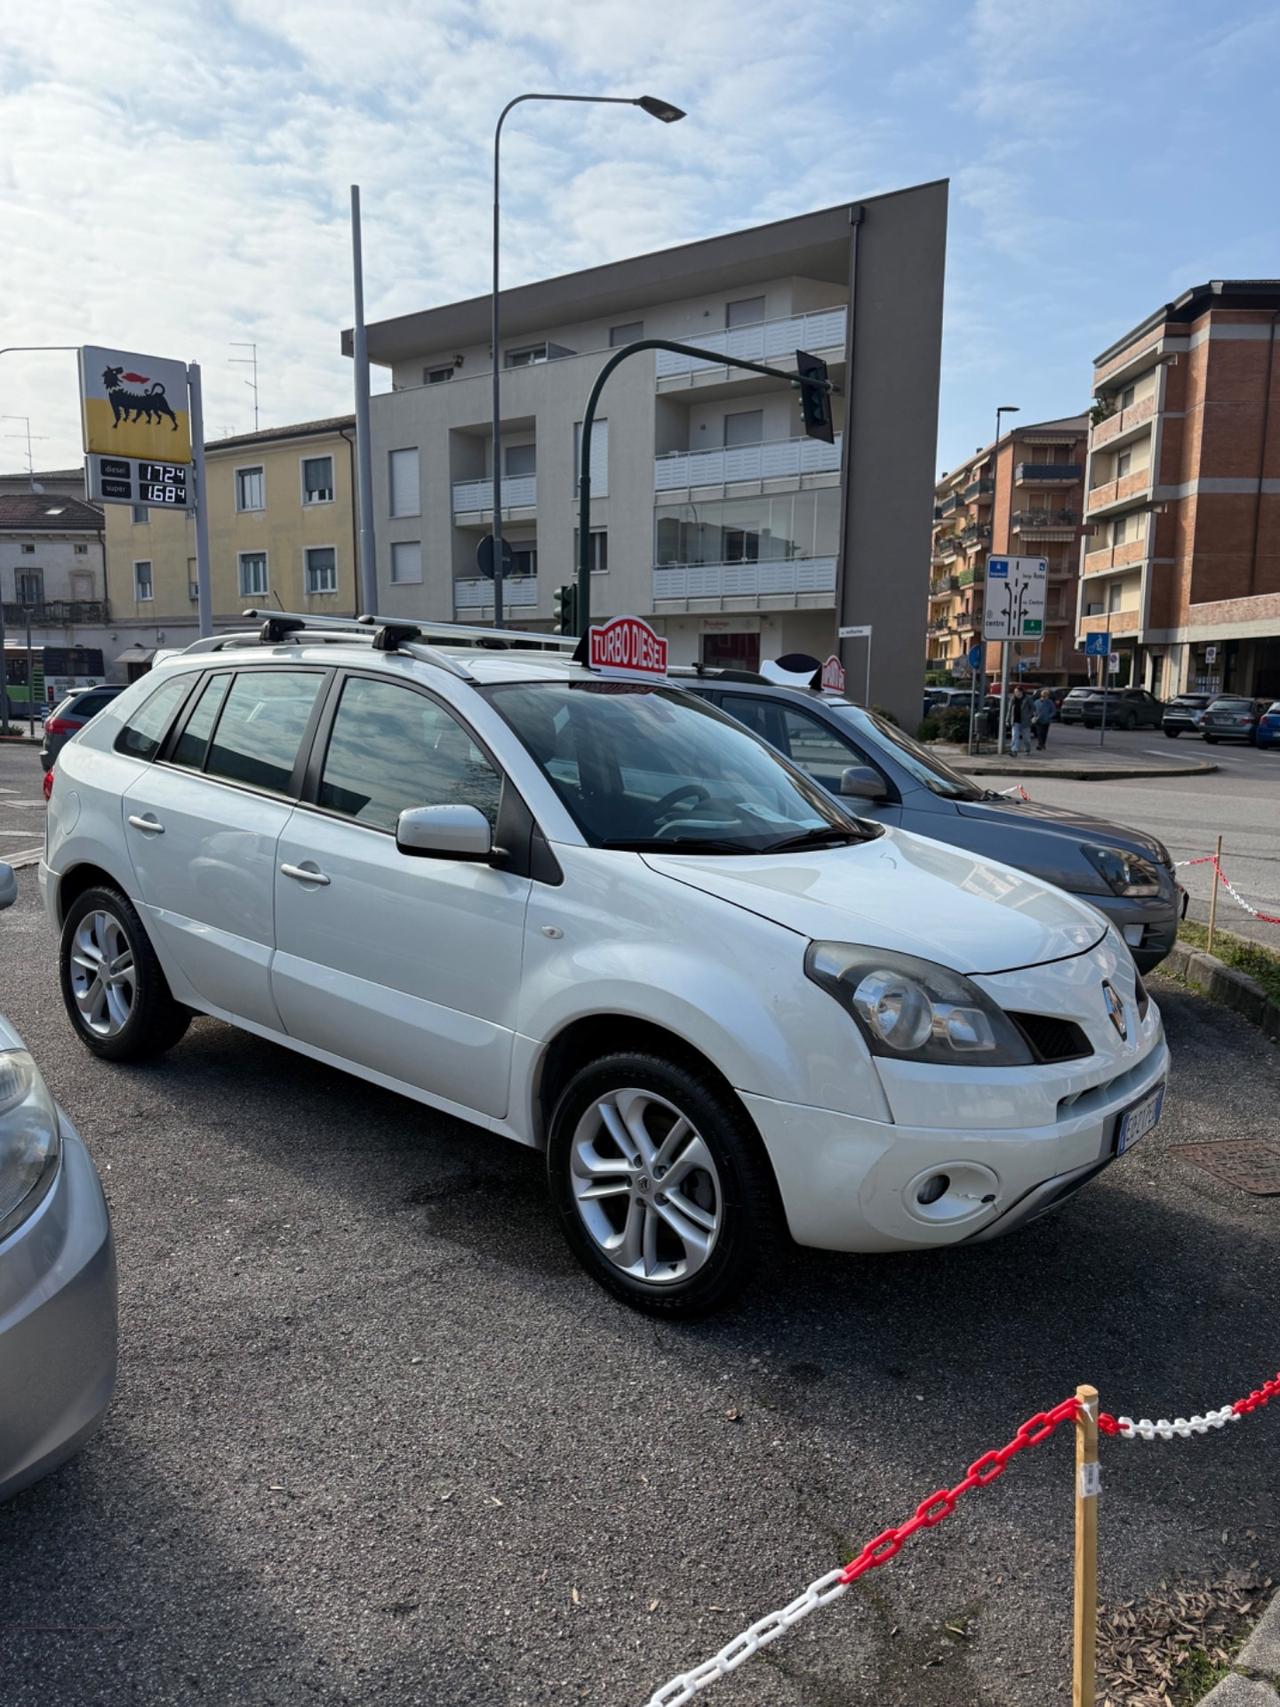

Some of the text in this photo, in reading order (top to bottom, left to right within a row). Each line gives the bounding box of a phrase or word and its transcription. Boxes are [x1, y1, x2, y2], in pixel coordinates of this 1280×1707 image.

[105, 464, 126, 474] diesel
[106, 485, 127, 494] super
[593, 623, 665, 670] TURBO DIESEL
